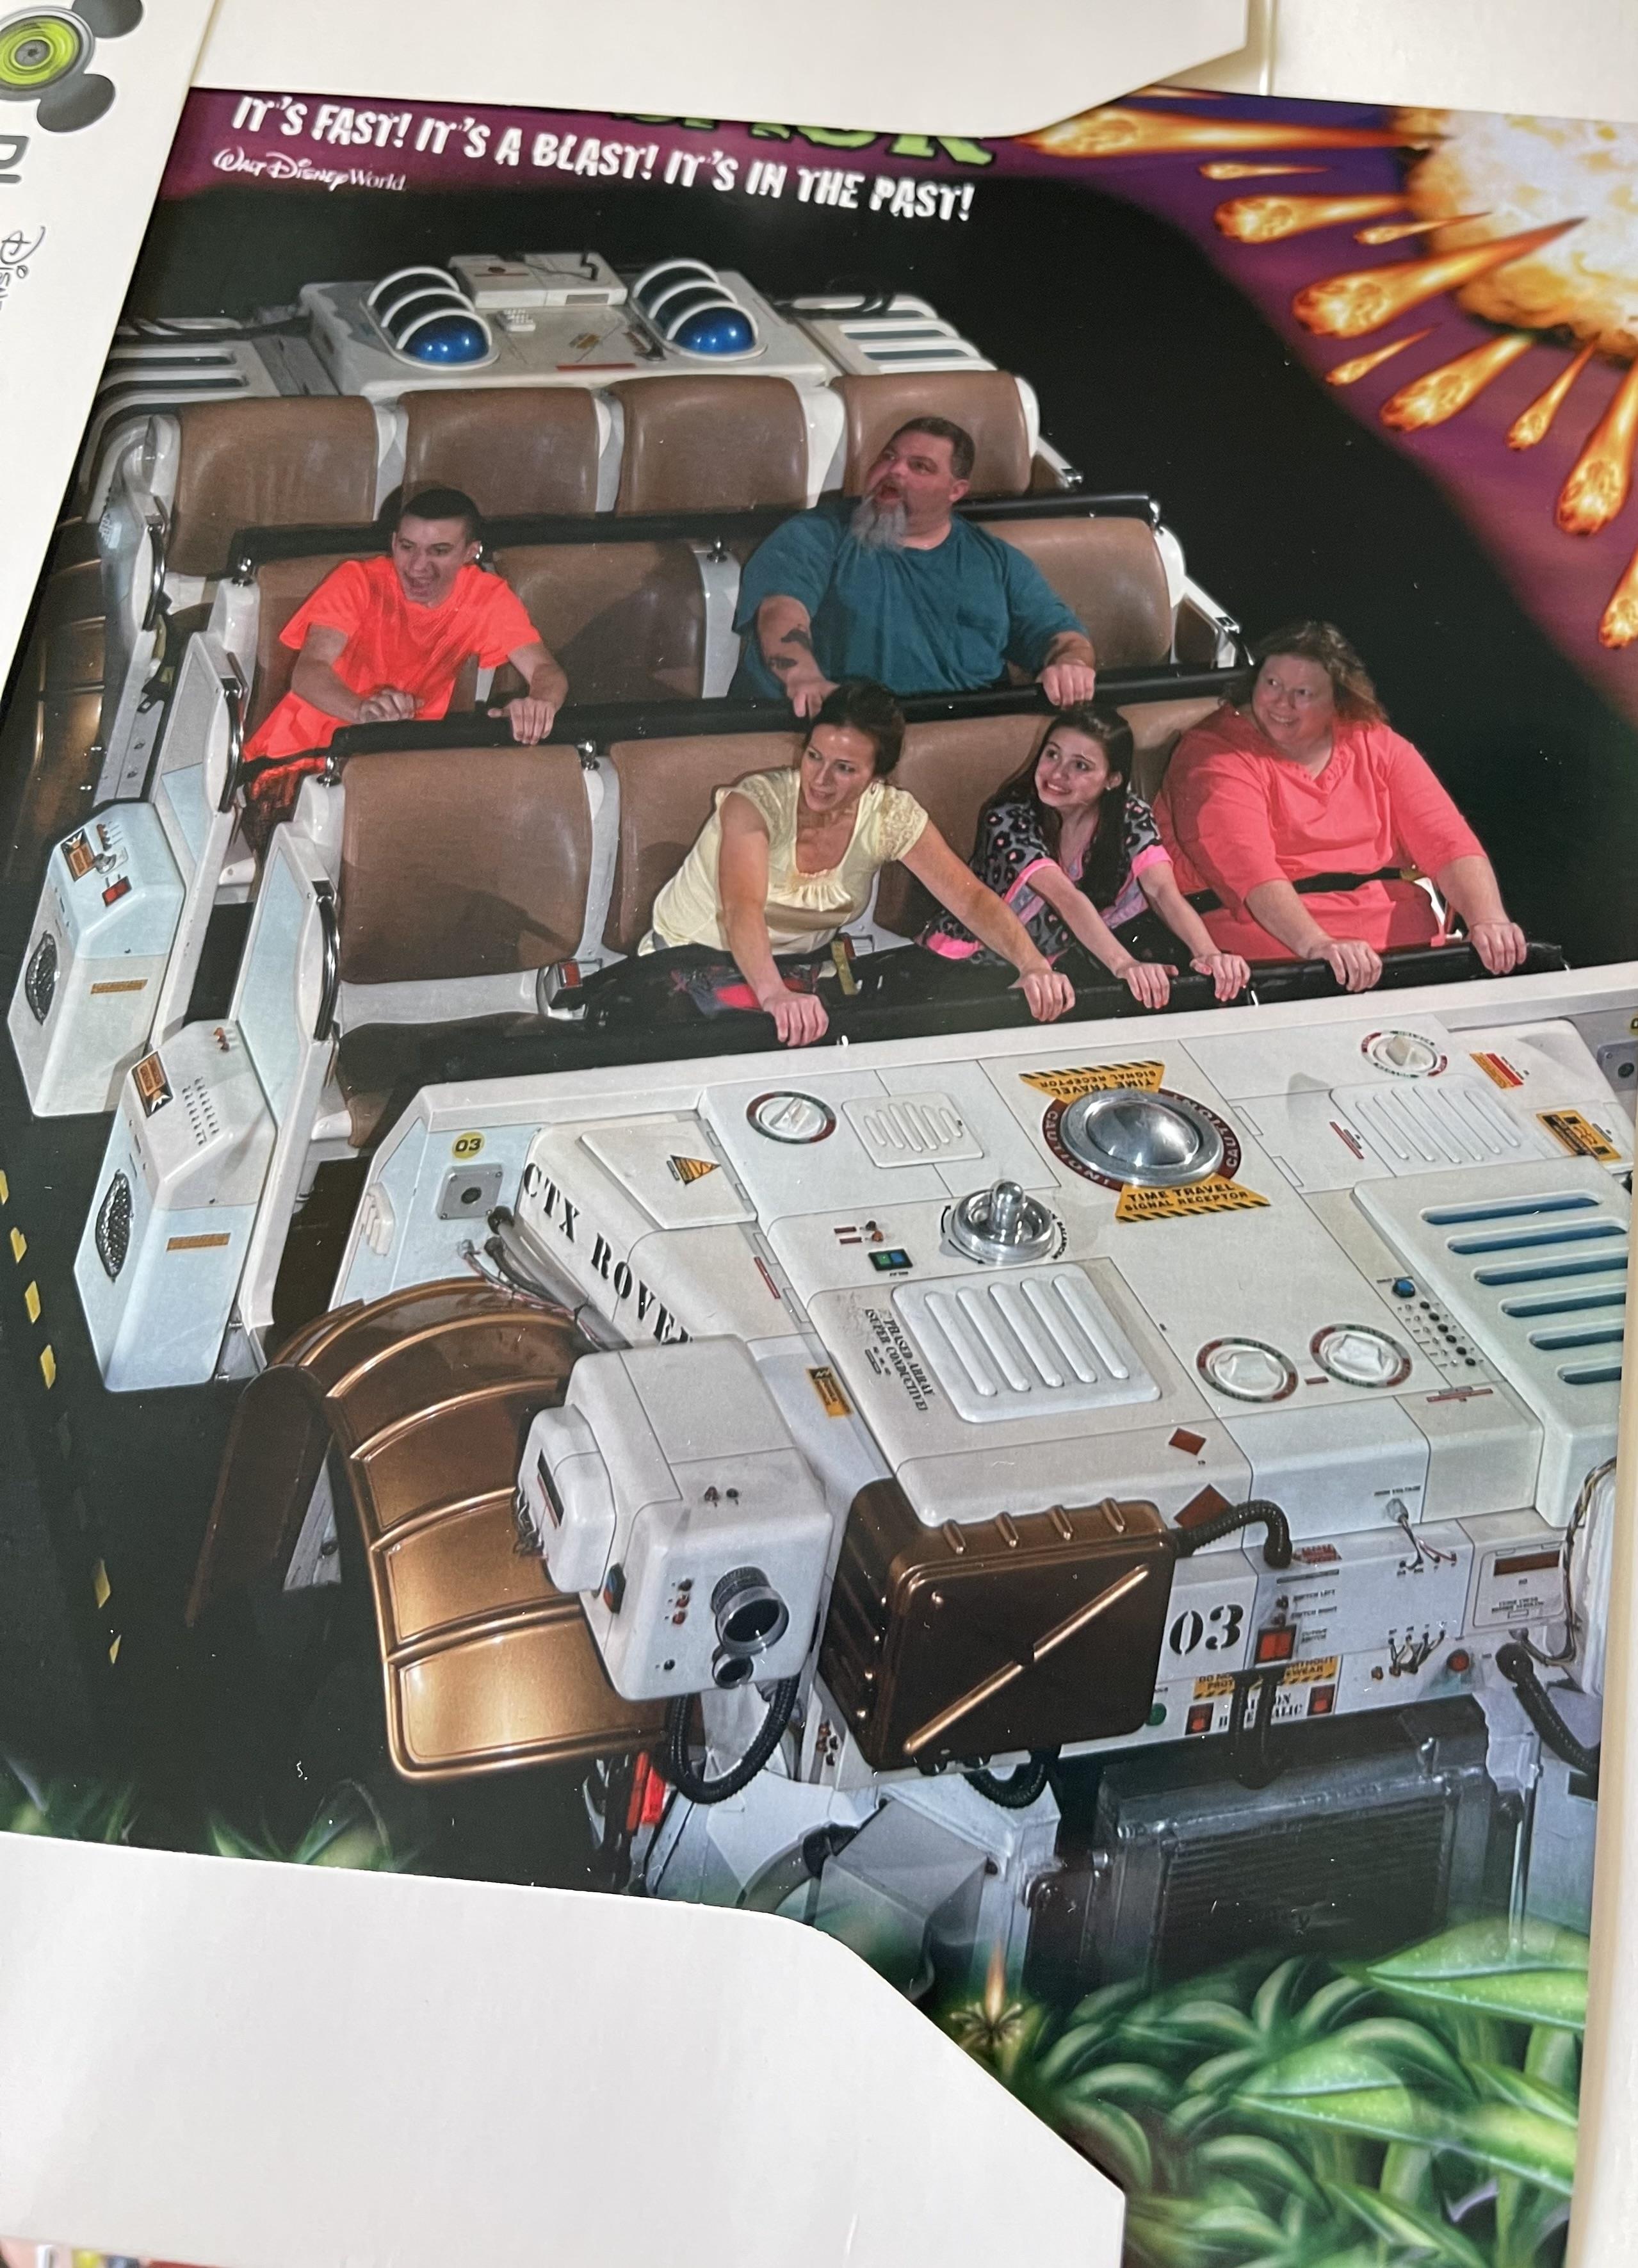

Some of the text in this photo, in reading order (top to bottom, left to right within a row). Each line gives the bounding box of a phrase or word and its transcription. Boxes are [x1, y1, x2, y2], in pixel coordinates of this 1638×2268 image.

[232, 96, 307, 136] IT'S
[311, 104, 412, 147] FAST!
[416, 117, 491, 158] IT'S
[494, 128, 523, 166] A
[532, 133, 660, 180] BLAST!
[663, 150, 738, 192] IT'S
[745, 161, 788, 199] IN
[796, 167, 864, 209] THE
[869, 176, 975, 222] PAST!
[350, 168, 405, 191] World
[1040, 1075, 1107, 1088] RECEPTOR
[455, 1138, 482, 1152] 03
[524, 1163, 580, 1243] CTX
[1124, 1191, 1248, 1211] SIGNAL RECEPTOR
[1127, 1183, 1235, 1203] TIME TRAVEL
[1169, 1604, 1244, 1655] 03
